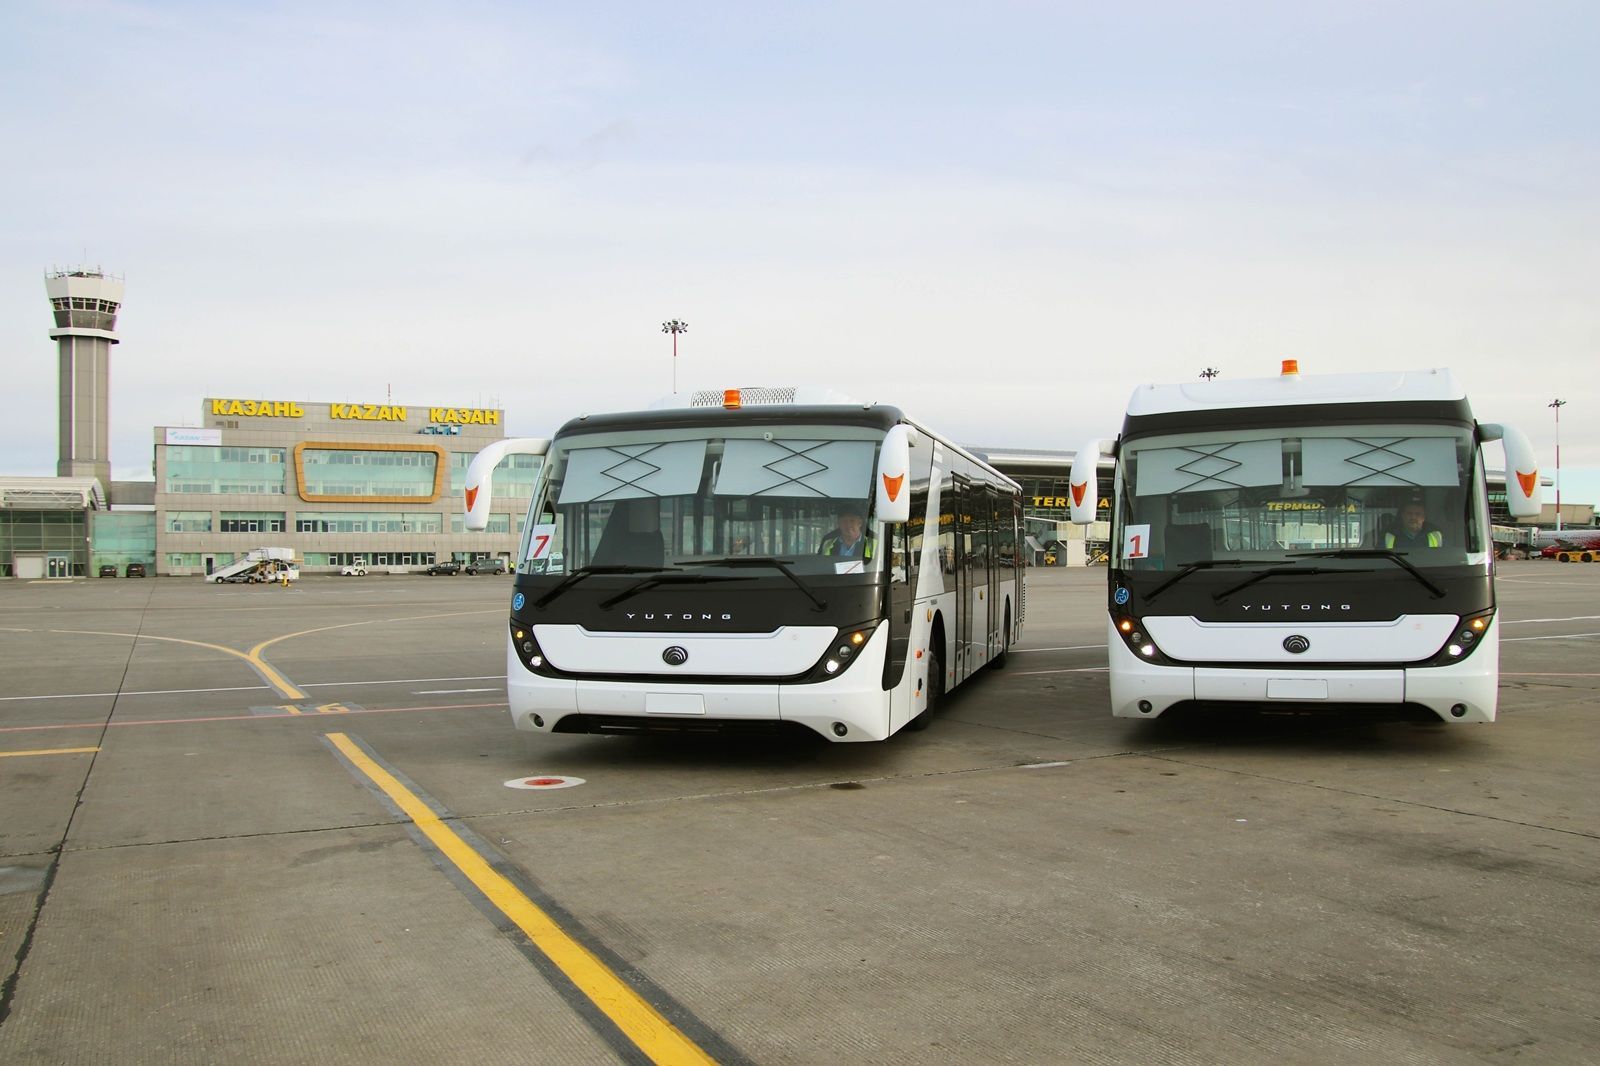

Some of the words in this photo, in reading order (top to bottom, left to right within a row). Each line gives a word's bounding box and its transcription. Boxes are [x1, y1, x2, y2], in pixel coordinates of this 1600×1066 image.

[212, 399, 305, 418] КАЗАНЬ
[330, 403, 407, 421] KAZAN
[429, 407, 499, 425] КАЗАН
[533, 534, 550, 559] 7
[1128, 534, 1144, 558] 1
